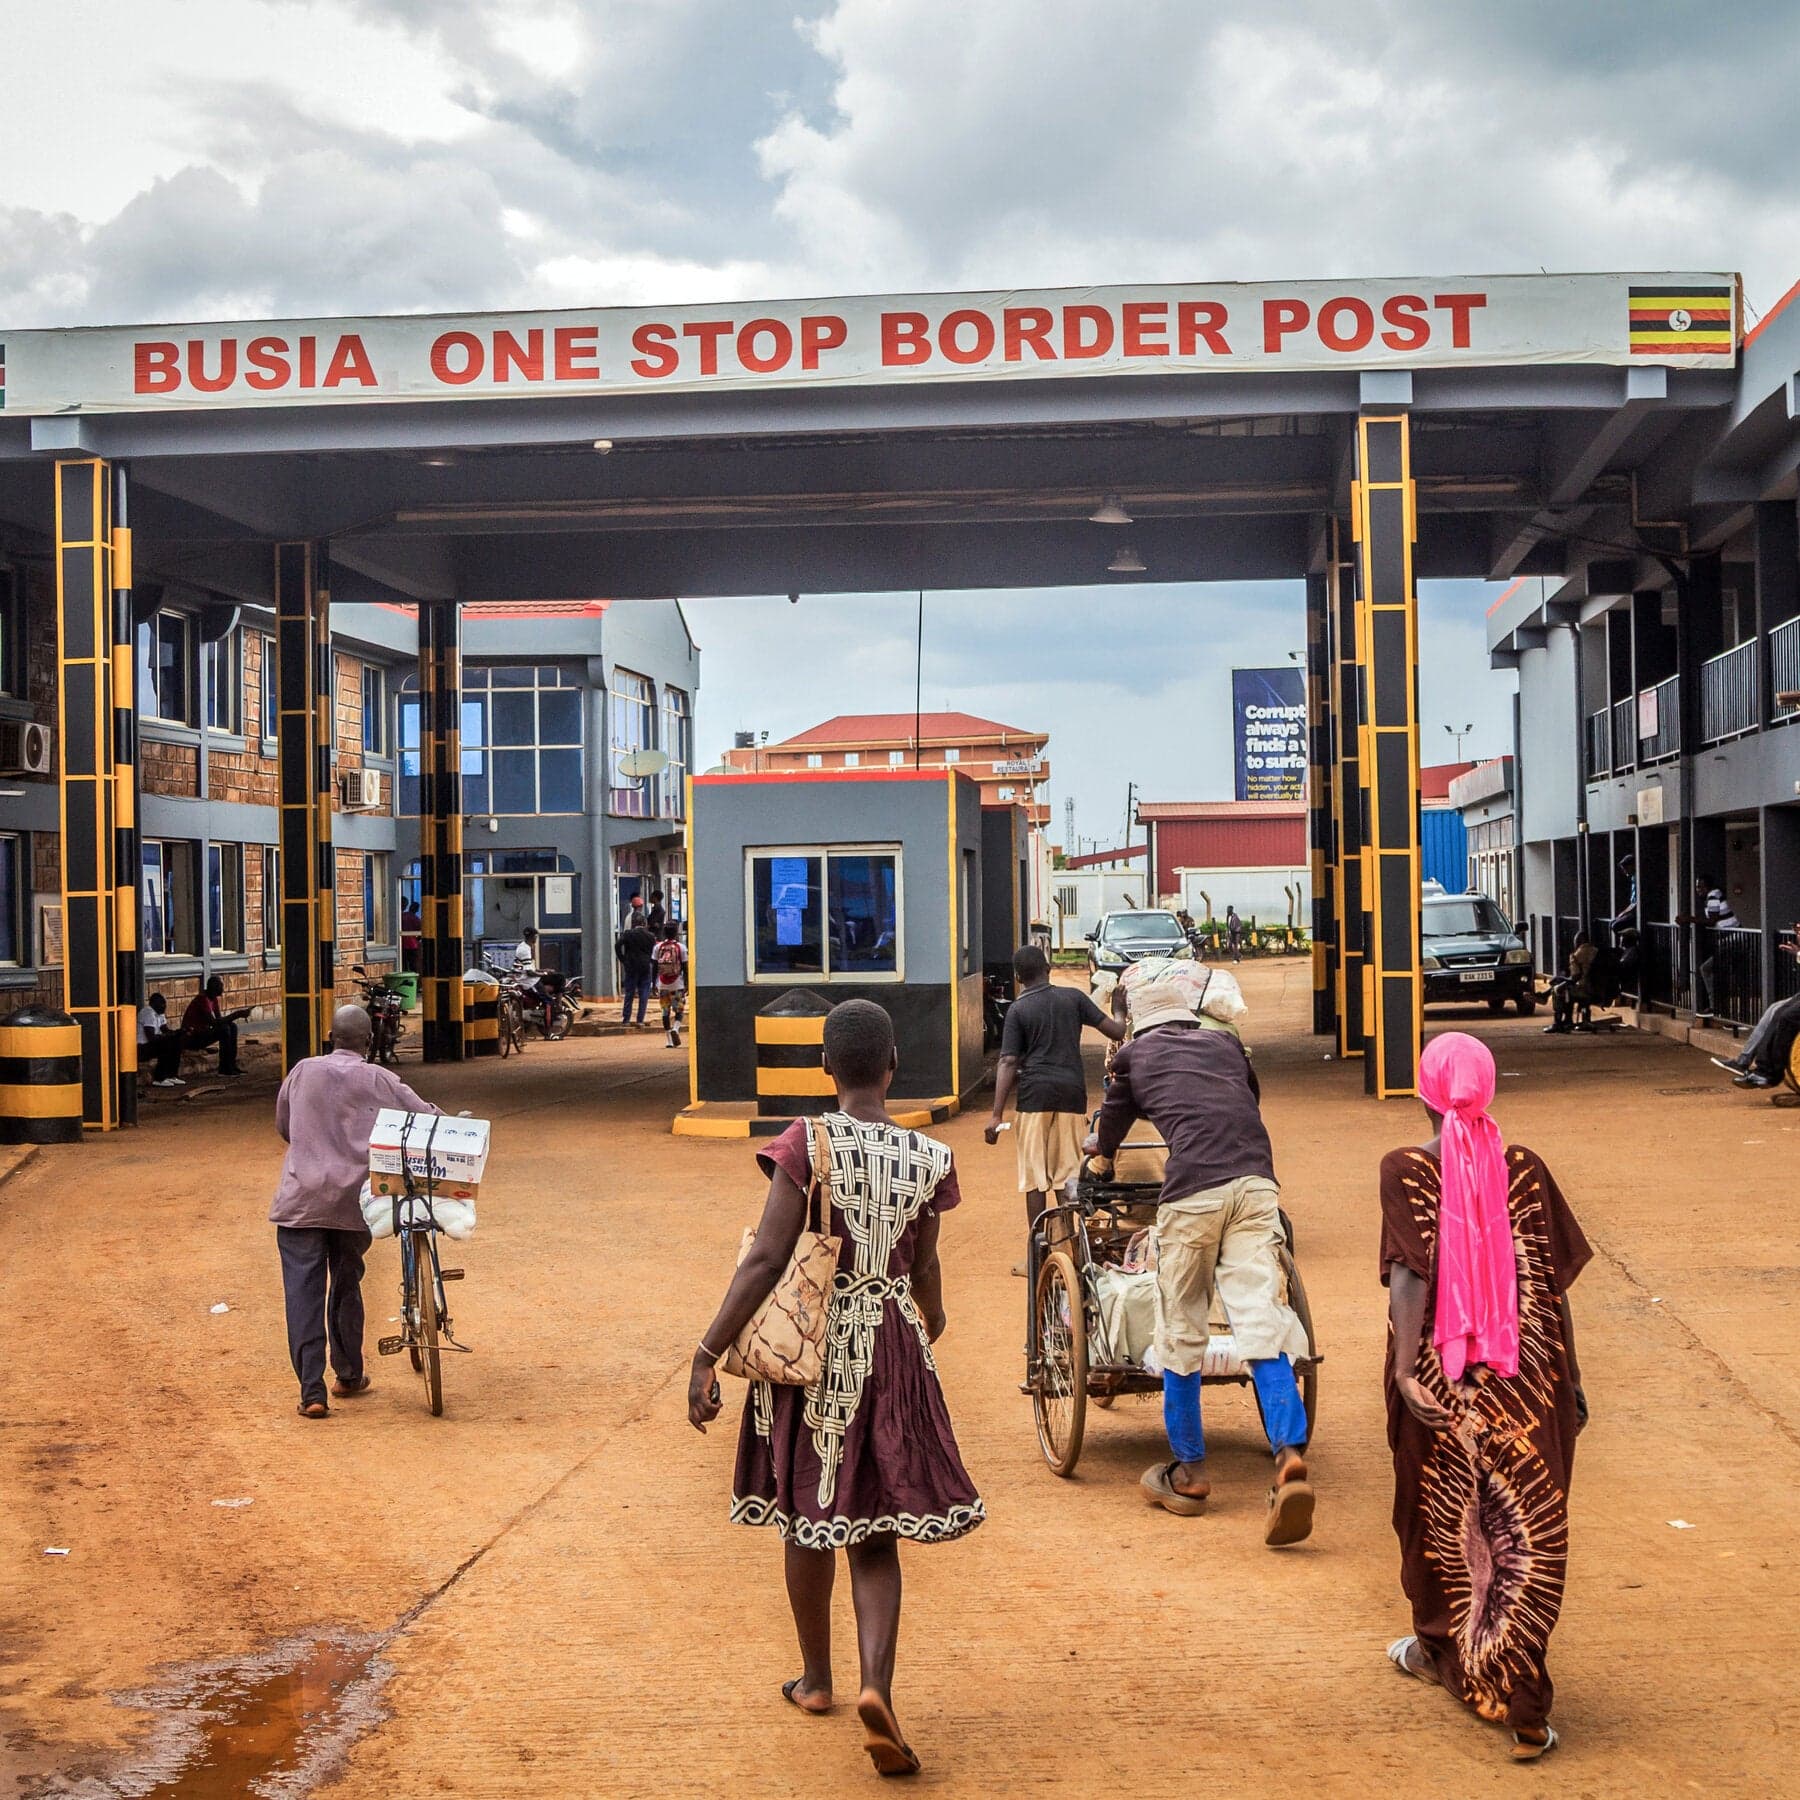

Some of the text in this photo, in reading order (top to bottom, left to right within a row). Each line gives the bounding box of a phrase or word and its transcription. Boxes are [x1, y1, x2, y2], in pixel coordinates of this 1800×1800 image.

[135, 295, 1484, 393] BUSIA ONE STOP BORDER POST
[1245, 721, 1299, 737] always
[1246, 738, 1286, 752] finds
[1288, 741, 1299, 752] a
[1246, 755, 1264, 769] to
[1258, 775, 1282, 783] matter
[1273, 784, 1289, 793] your
[1247, 792, 1258, 800] will
[1260, 791, 1293, 800] eventually
[412, 1165, 447, 1178] Wite
